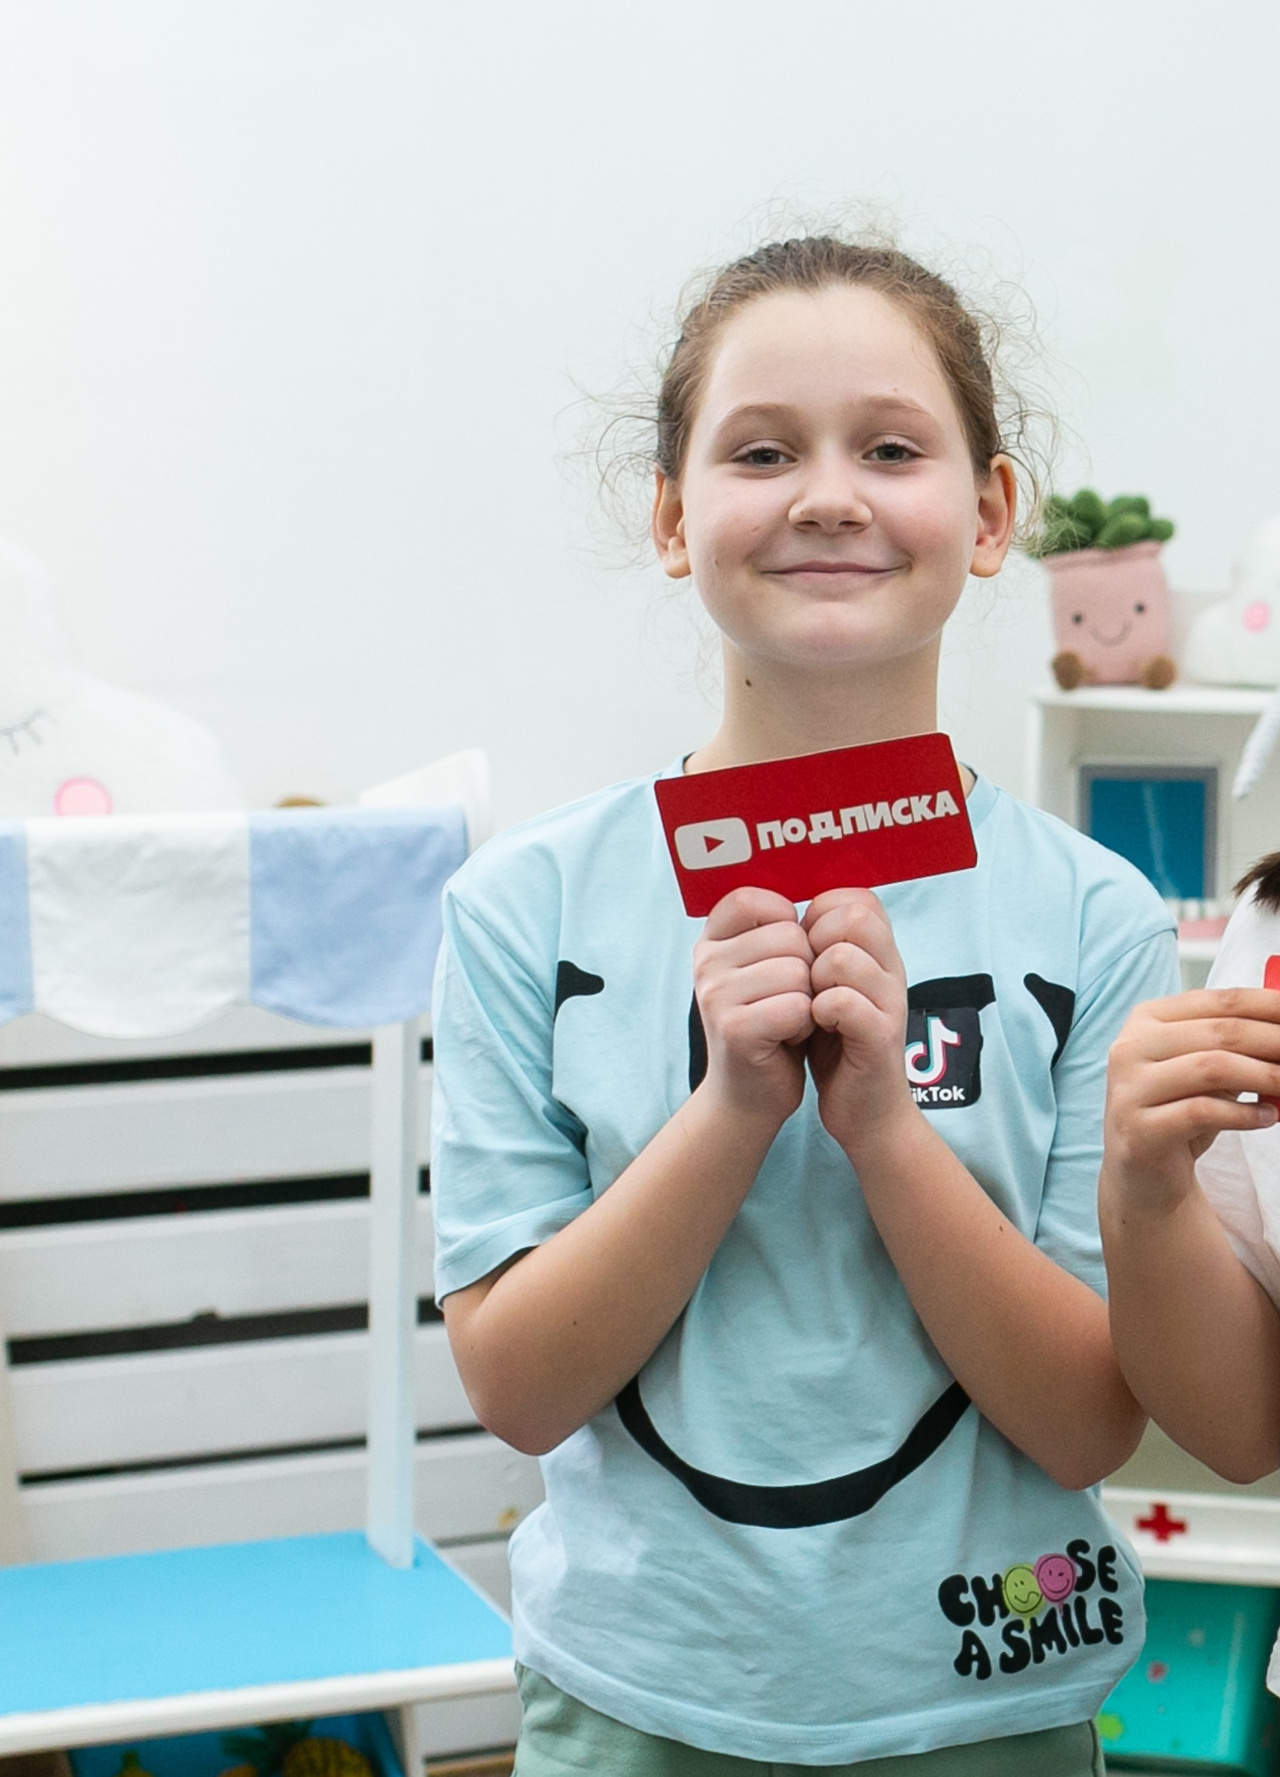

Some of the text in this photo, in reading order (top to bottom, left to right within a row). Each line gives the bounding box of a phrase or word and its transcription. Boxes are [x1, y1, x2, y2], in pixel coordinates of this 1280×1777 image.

[755, 790, 960, 851] ПОДПИСКА
[909, 1085, 966, 1103] ikTok
[953, 1595, 1124, 1681] A SMILE
